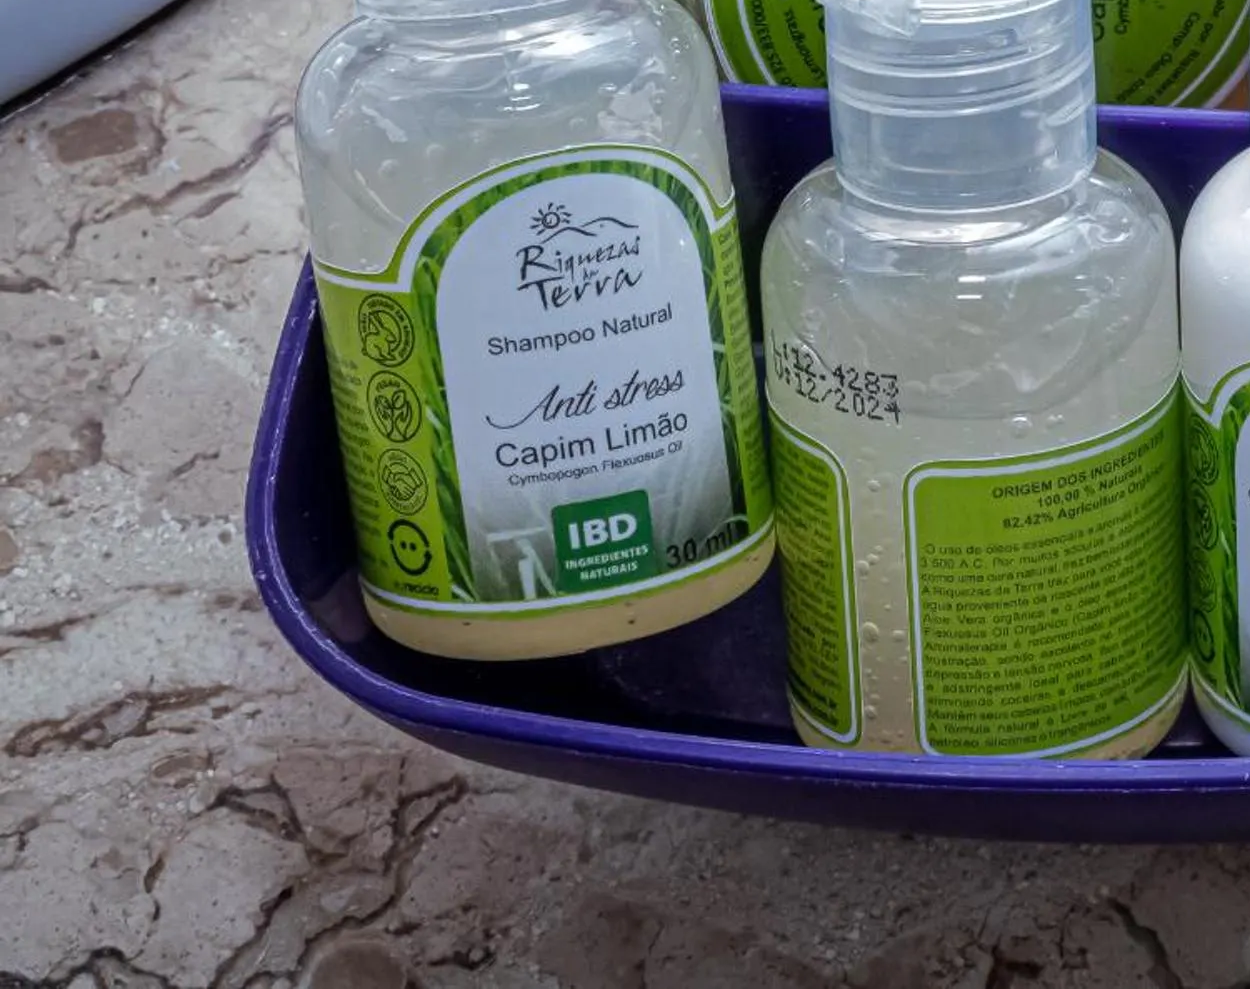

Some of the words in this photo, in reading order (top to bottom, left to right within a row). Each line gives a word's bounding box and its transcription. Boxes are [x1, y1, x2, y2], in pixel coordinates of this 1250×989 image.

[515, 235, 641, 284] Riquezas
[516, 267, 644, 311] Terra
[487, 326, 596, 356] Shampoo
[602, 302, 673, 338] Natural
[485, 379, 598, 430] Anti
[603, 369, 686, 410] stress
[495, 435, 596, 468] Capim
[605, 412, 688, 452] Limão
[991, 480, 1053, 499] ORIGEM
[1057, 471, 1087, 488] DOS
[568, 512, 638, 550] IBD
[665, 537, 698, 569] 30
[707, 522, 735, 555] ml
[565, 543, 649, 570] INGREDIENTES
[579, 560, 639, 581] NATURAIS
